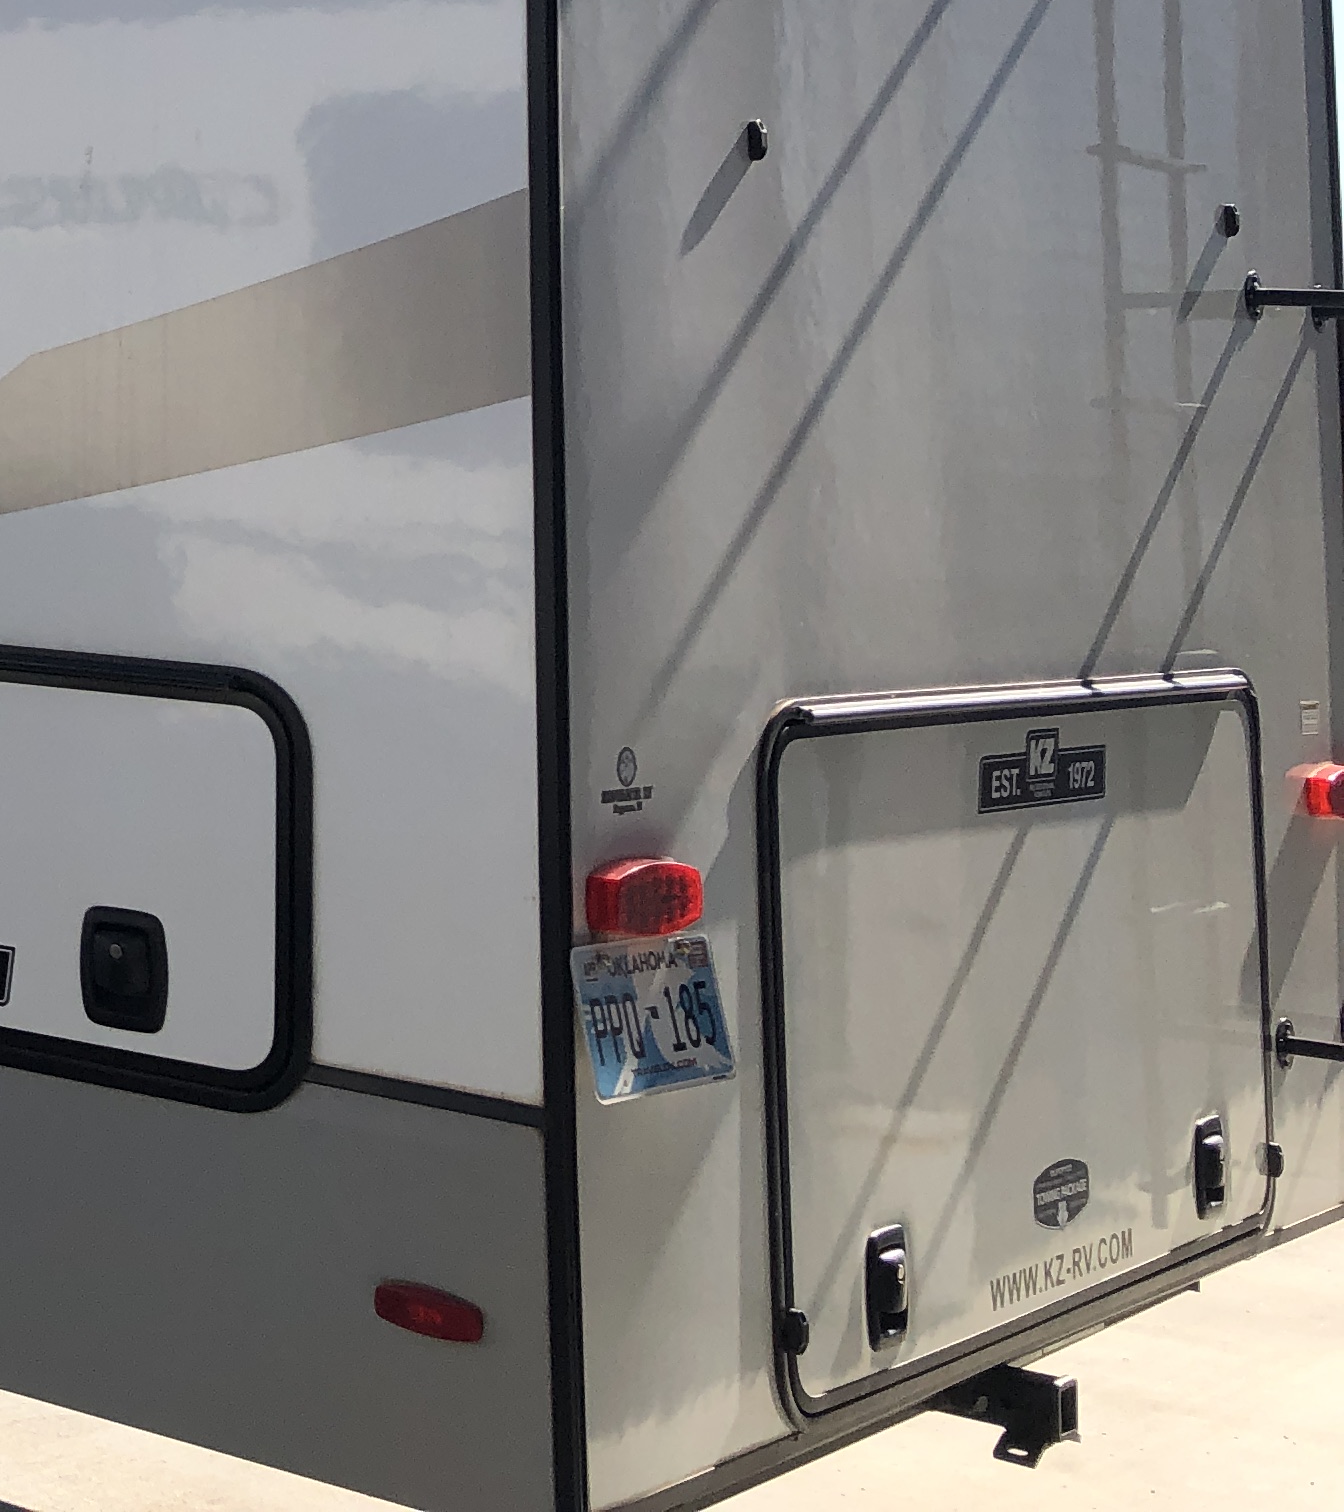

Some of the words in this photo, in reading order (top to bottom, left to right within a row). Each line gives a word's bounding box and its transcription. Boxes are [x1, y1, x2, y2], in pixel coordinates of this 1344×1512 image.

[1029, 738, 1055, 775] KZ
[991, 768, 1021, 798] EST.
[1067, 761, 1095, 789] 1972
[607, 950, 678, 977] OKLAHOMA
[989, 1228, 1133, 1312] WWW.KZ-RV.COM
